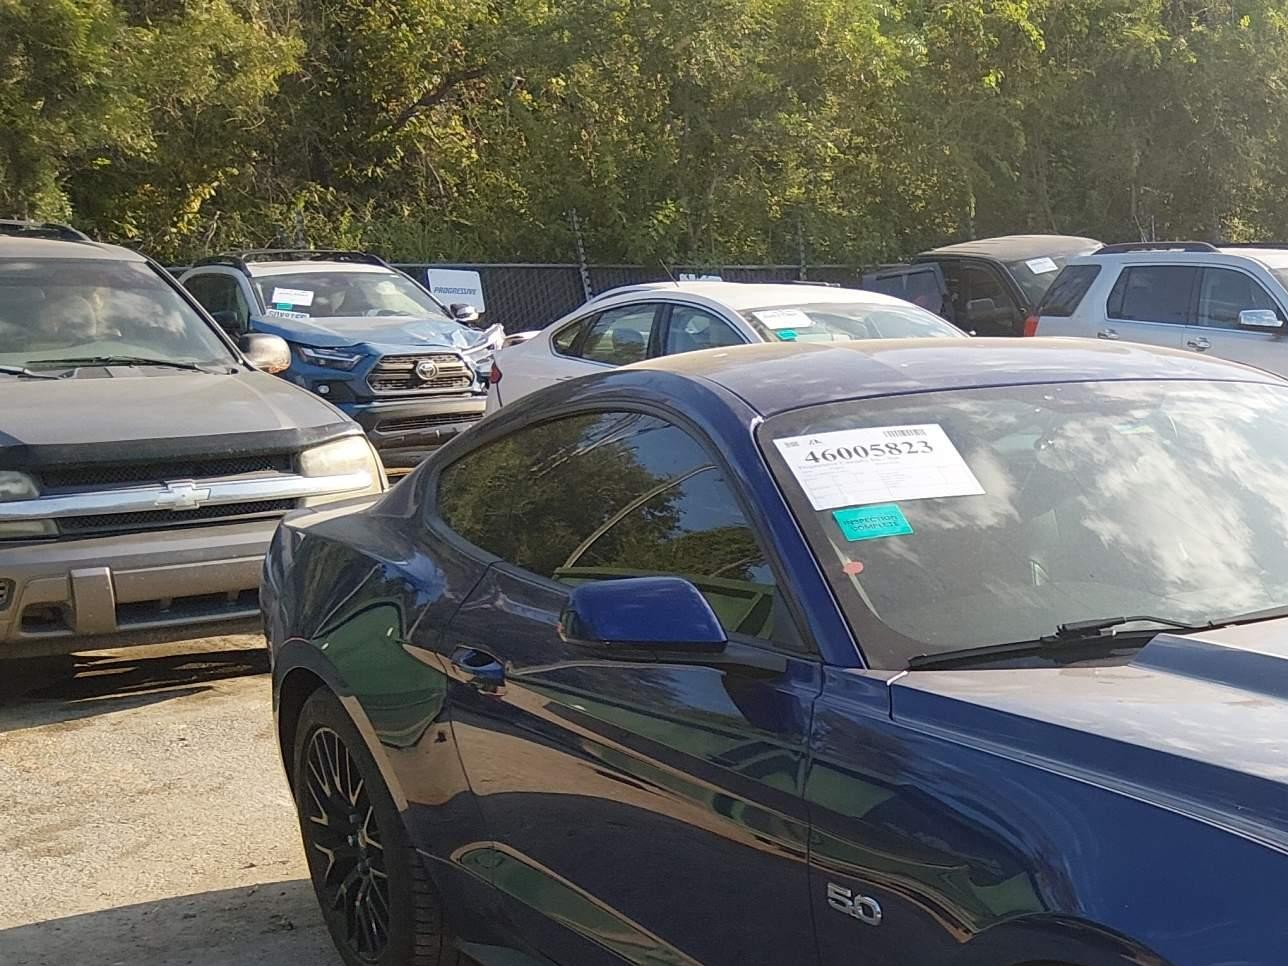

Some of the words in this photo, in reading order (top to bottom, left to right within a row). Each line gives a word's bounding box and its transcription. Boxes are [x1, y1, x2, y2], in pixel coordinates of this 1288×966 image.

[433, 286, 478, 296] PROGRESSIVE
[804, 439, 935, 464] 46005823
[843, 514, 898, 526] INSPECTION
[852, 521, 900, 532] COMPLETE
